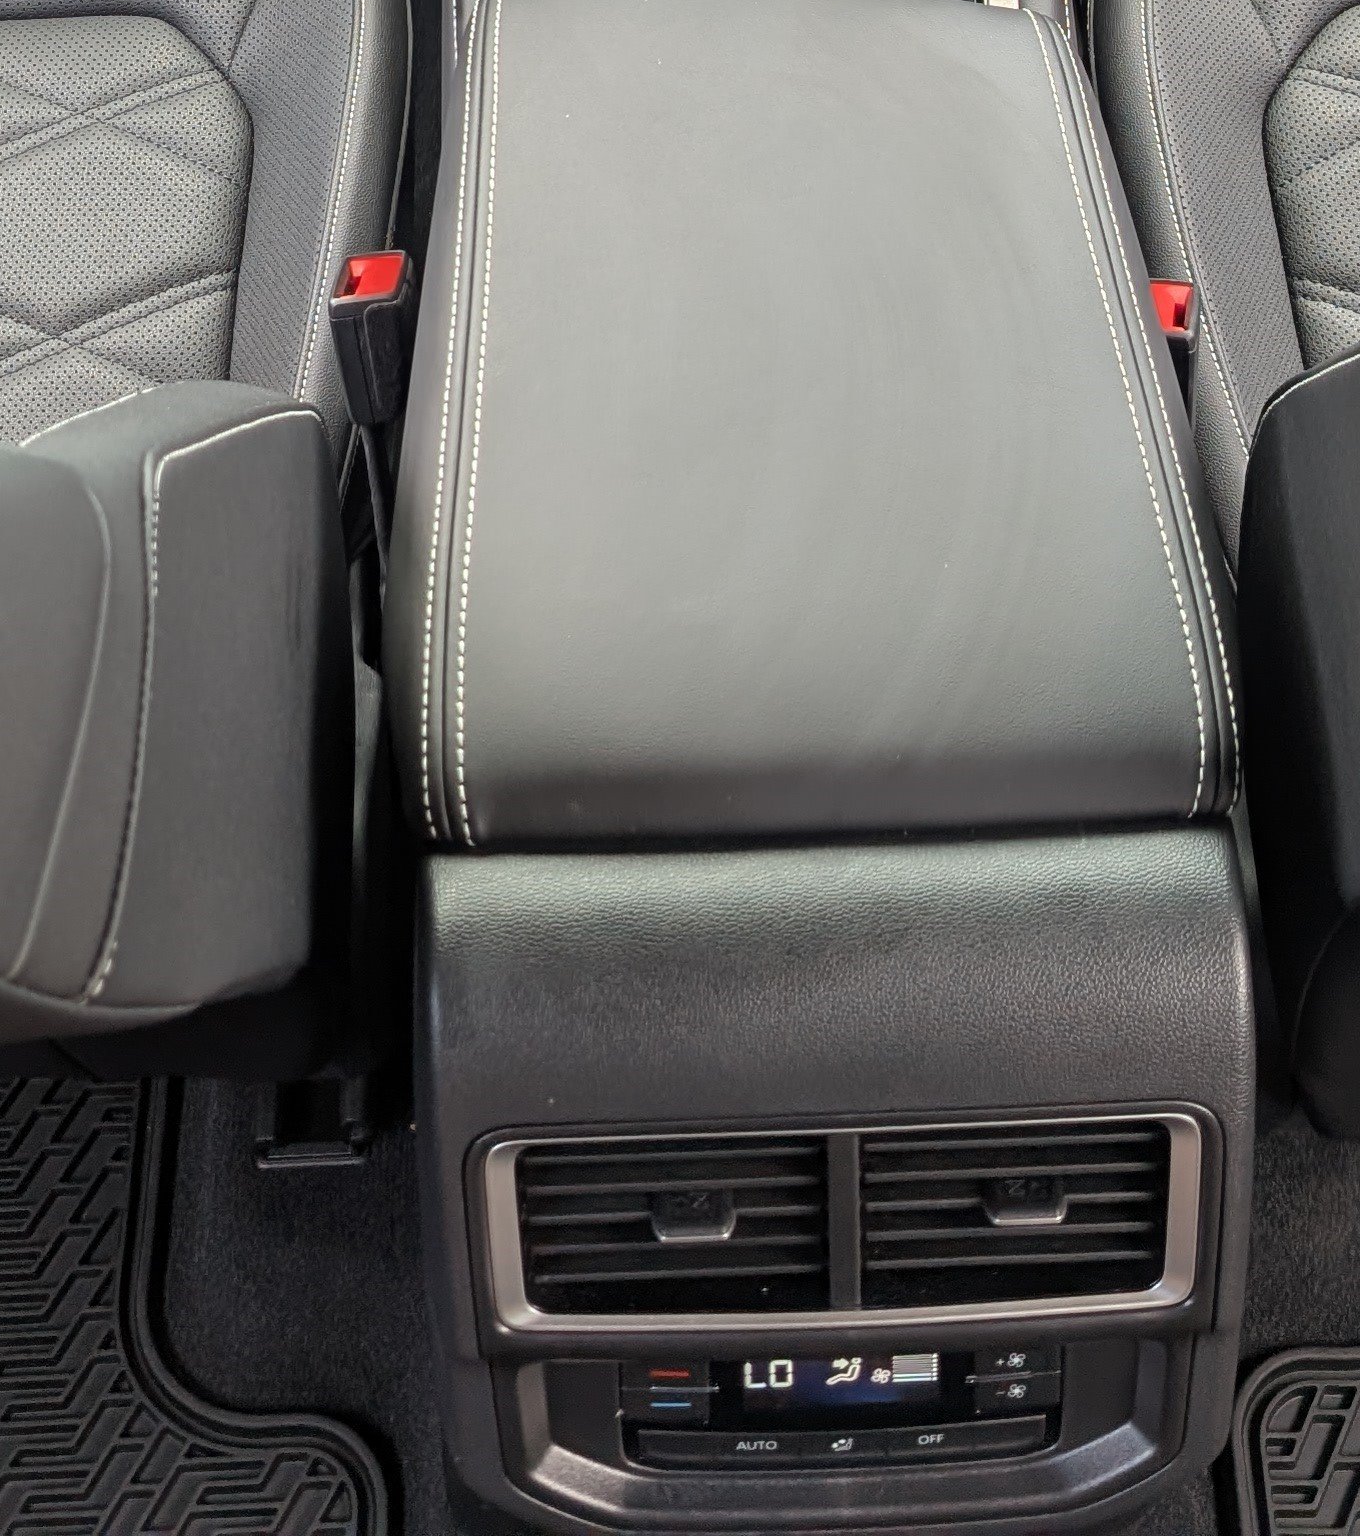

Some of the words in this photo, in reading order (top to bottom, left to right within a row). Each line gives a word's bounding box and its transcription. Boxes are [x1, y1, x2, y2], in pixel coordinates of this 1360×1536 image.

[743, 1359, 794, 1390] LO
[736, 1439, 777, 1451] AUTO
[918, 1432, 945, 1445] OFF
